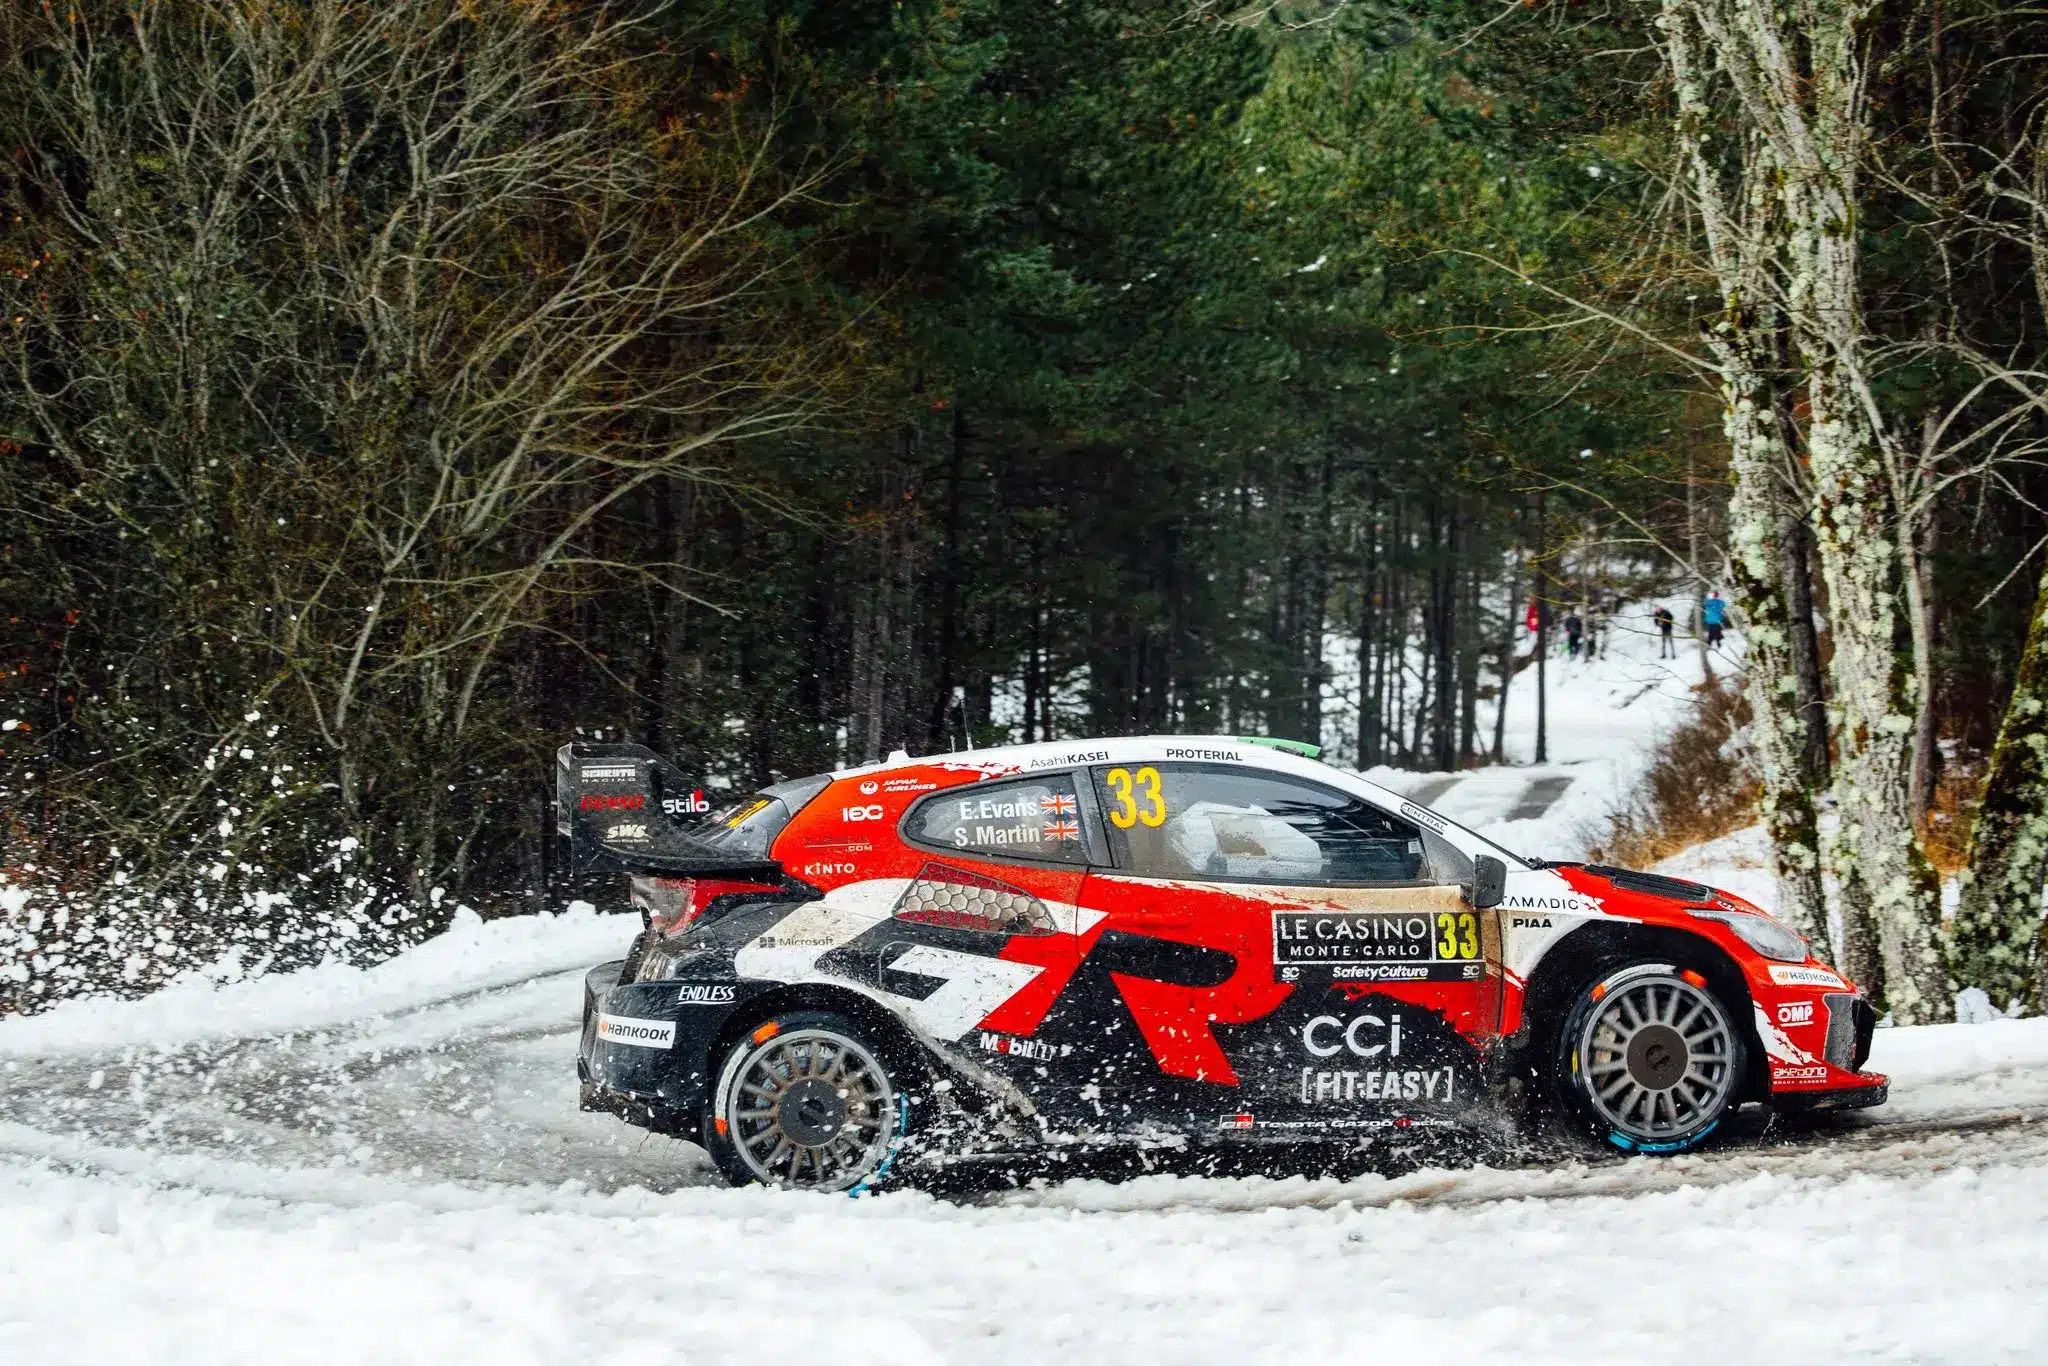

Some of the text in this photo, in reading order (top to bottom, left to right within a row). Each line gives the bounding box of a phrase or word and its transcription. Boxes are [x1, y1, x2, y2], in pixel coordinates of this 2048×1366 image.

[1030, 751, 1109, 769] AsahiKASEI
[1166, 748, 1242, 761] PROTERIAL
[884, 783, 937, 792] AIRLINES
[1107, 766, 1167, 829] 33
[606, 824, 649, 838] SWS
[1281, 918, 1427, 940] LE CASINO
[1513, 918, 1553, 928] PIAA
[778, 936, 835, 947] Microsoft
[1437, 912, 1479, 959] 33
[1282, 967, 1300, 978] SC
[1332, 965, 1429, 980] SafetyCulture
[1462, 965, 1480, 977] SC
[678, 985, 736, 1001] ENDLESS
[1777, 1005, 1814, 1023] OMP
